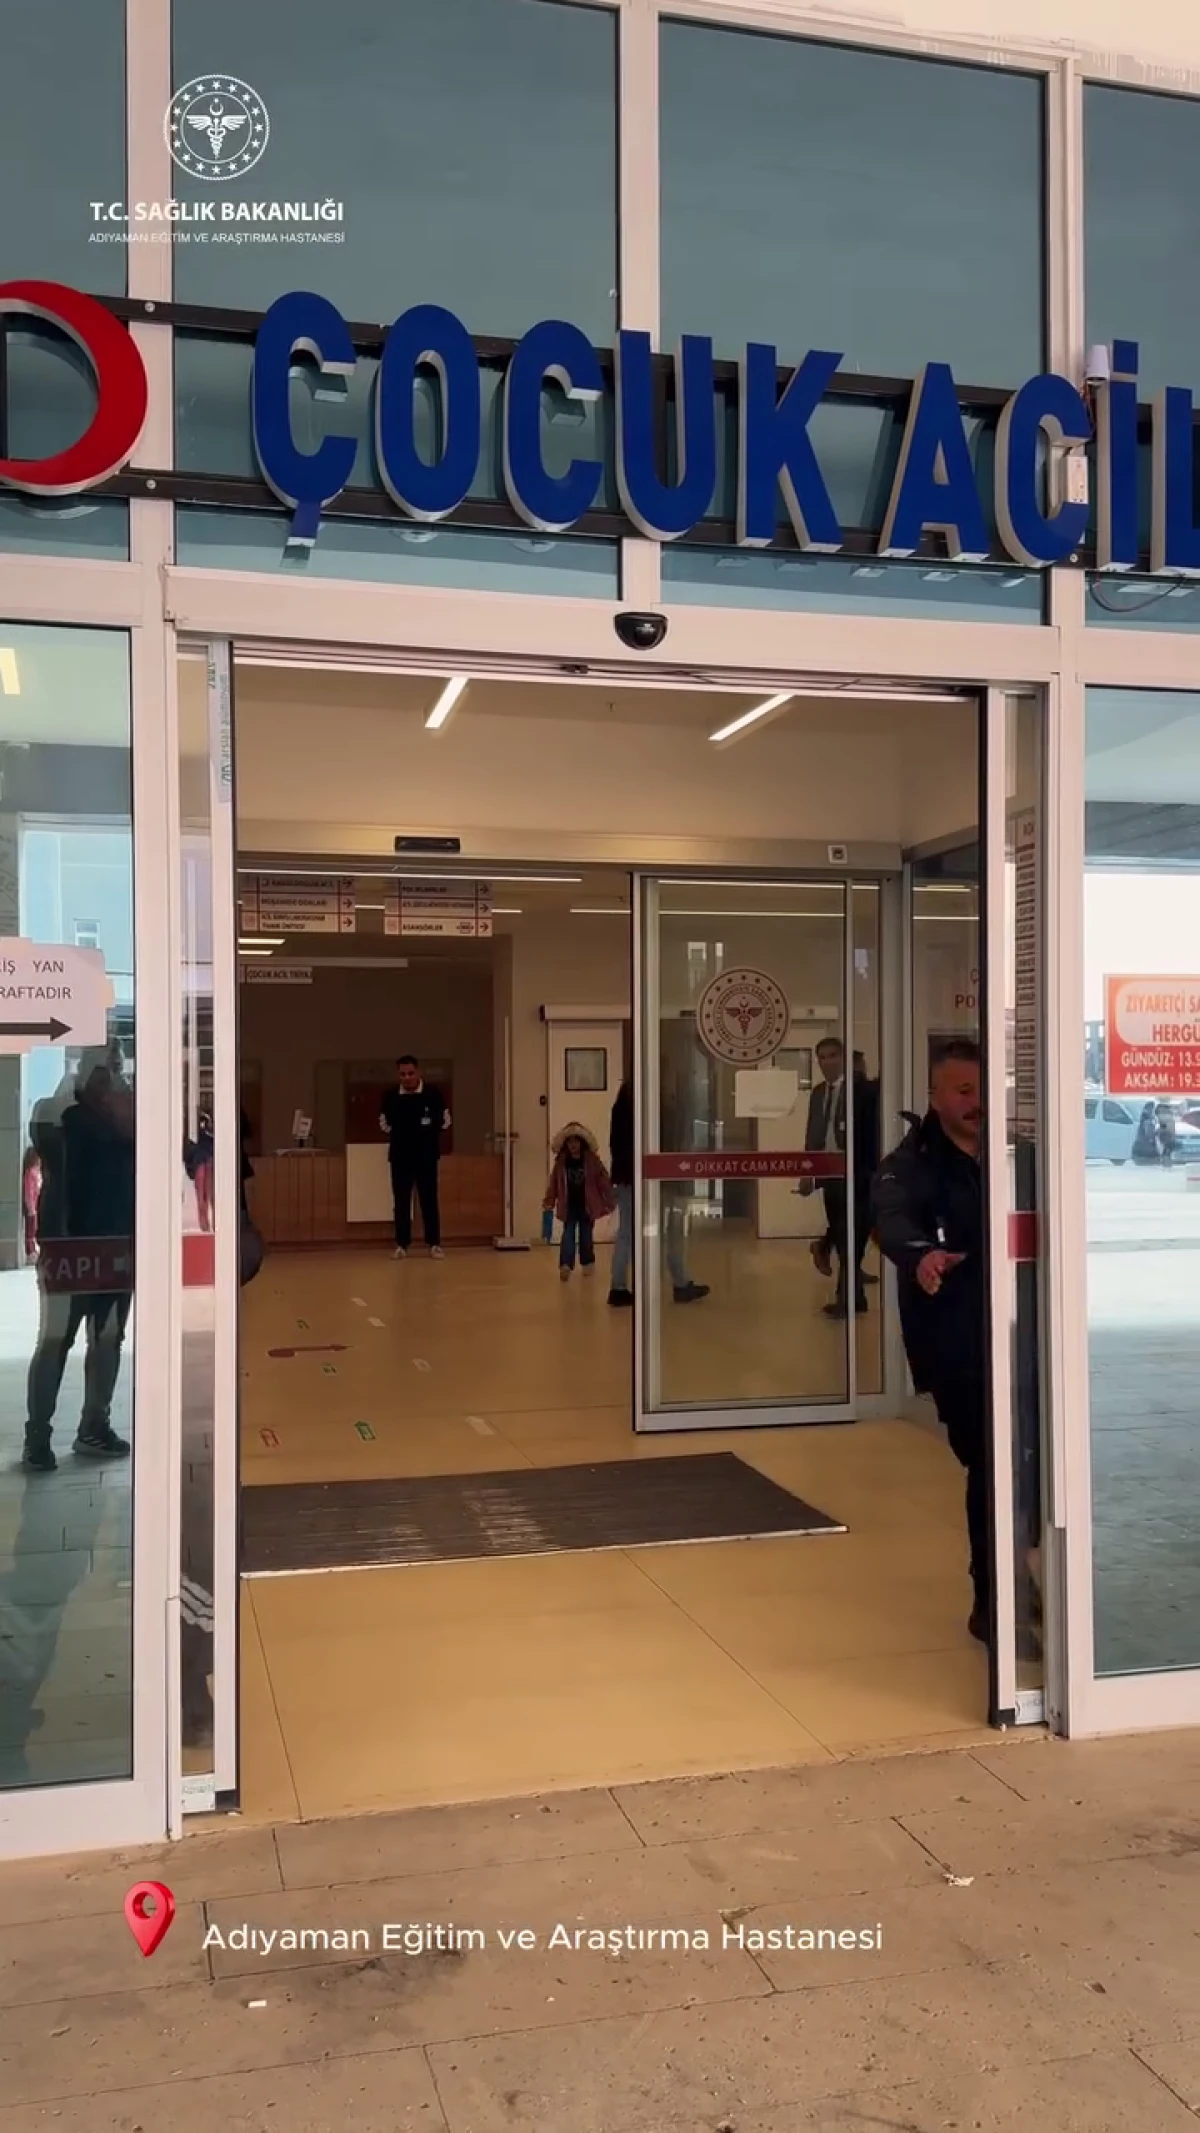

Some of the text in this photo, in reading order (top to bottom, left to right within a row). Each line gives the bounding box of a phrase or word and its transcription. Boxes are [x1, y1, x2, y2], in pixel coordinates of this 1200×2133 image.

[252, 290, 1200, 572] ÇOCUK ACİL
[32, 960, 65, 973] YAN
[1126, 990, 1186, 1017] ZİYARETÇİ
[1121, 1047, 1174, 1067] GÜNDÜZ:
[741, 1160, 769, 1173] CAM
[769, 1160, 798, 1172] KAPI
[41, 1255, 102, 1281] KAPI
